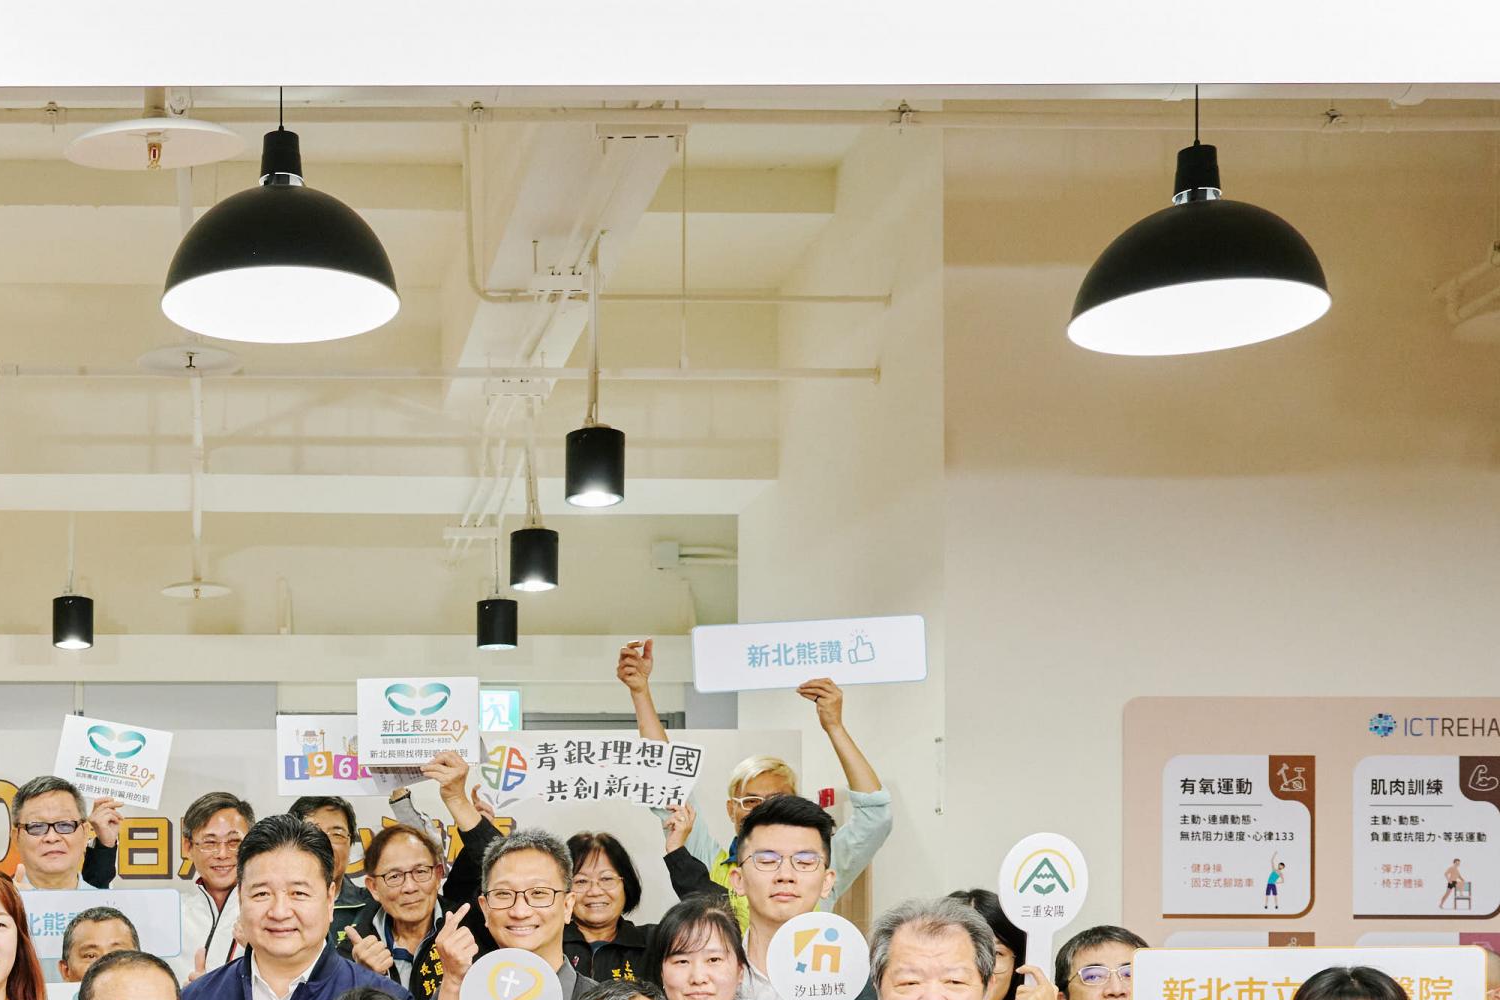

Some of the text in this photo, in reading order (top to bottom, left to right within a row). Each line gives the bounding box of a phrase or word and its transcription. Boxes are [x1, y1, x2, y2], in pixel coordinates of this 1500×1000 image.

[382, 719, 461, 733] 新北長照 2.0
[78, 756, 149, 779] 新北長照 2.0
[292, 754, 371, 779] 196
[535, 740, 701, 778] 青銀理想國
[546, 774, 685, 806] 共創新生活
[1180, 778, 1252, 795] 有氧運動
[1370, 778, 1443, 796] 肌肉訓練
[1021, 905, 1065, 918] 三重安陽
